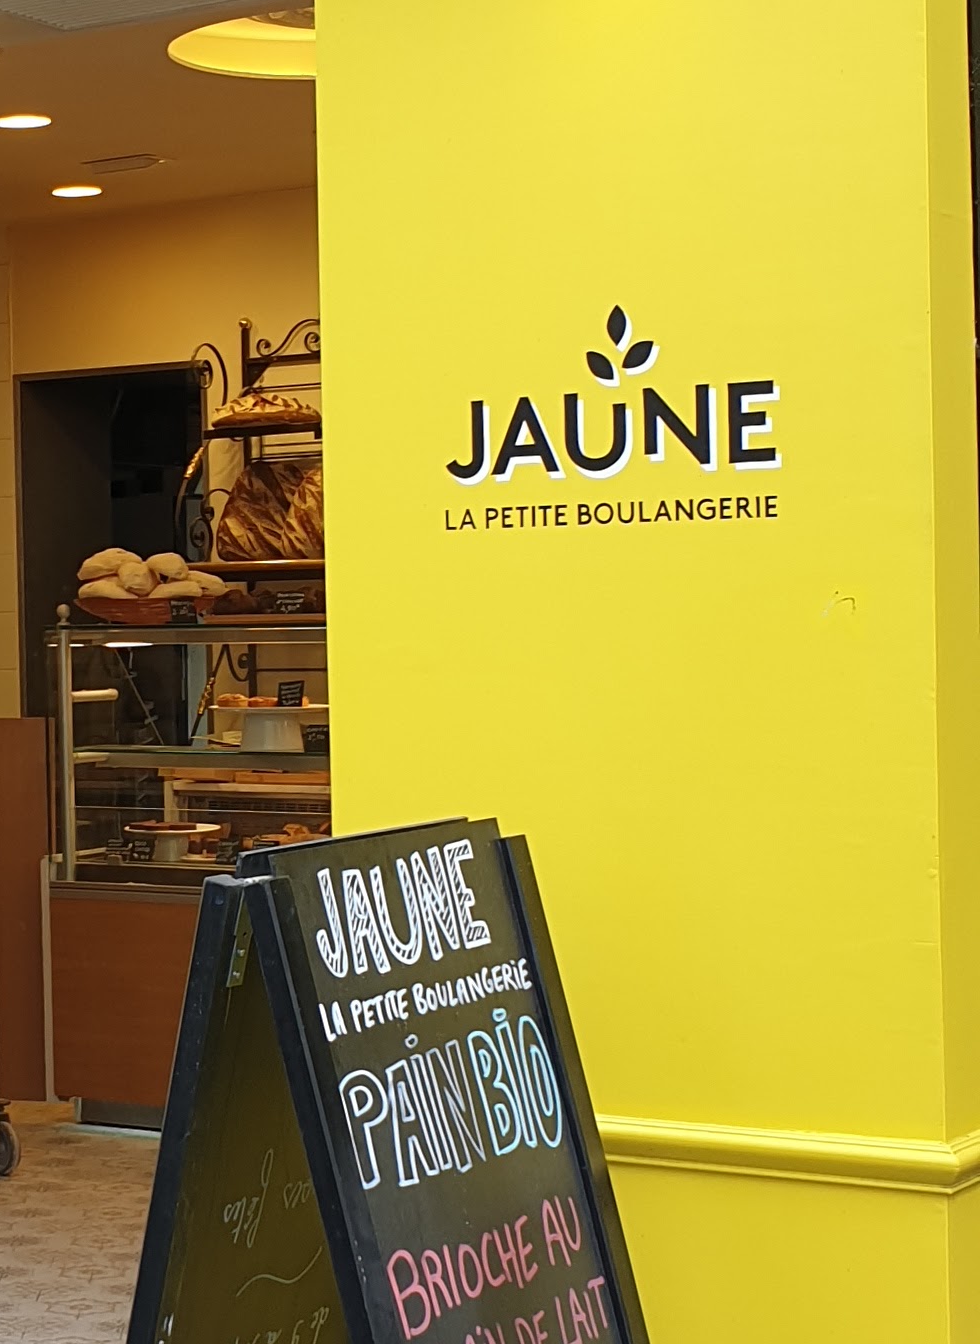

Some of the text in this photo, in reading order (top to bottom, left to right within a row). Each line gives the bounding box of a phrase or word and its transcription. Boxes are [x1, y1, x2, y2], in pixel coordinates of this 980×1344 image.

[446, 380, 782, 485] JAUNE
[445, 495, 779, 531] LA PETITE BOULANGERIE
[316, 838, 491, 978] JAUNE
[319, 958, 532, 1042] LA PETITE BOULANGERIE
[338, 1008, 563, 1190] PAIN BIO
[386, 1196, 581, 1340] BRIOCHE AU
